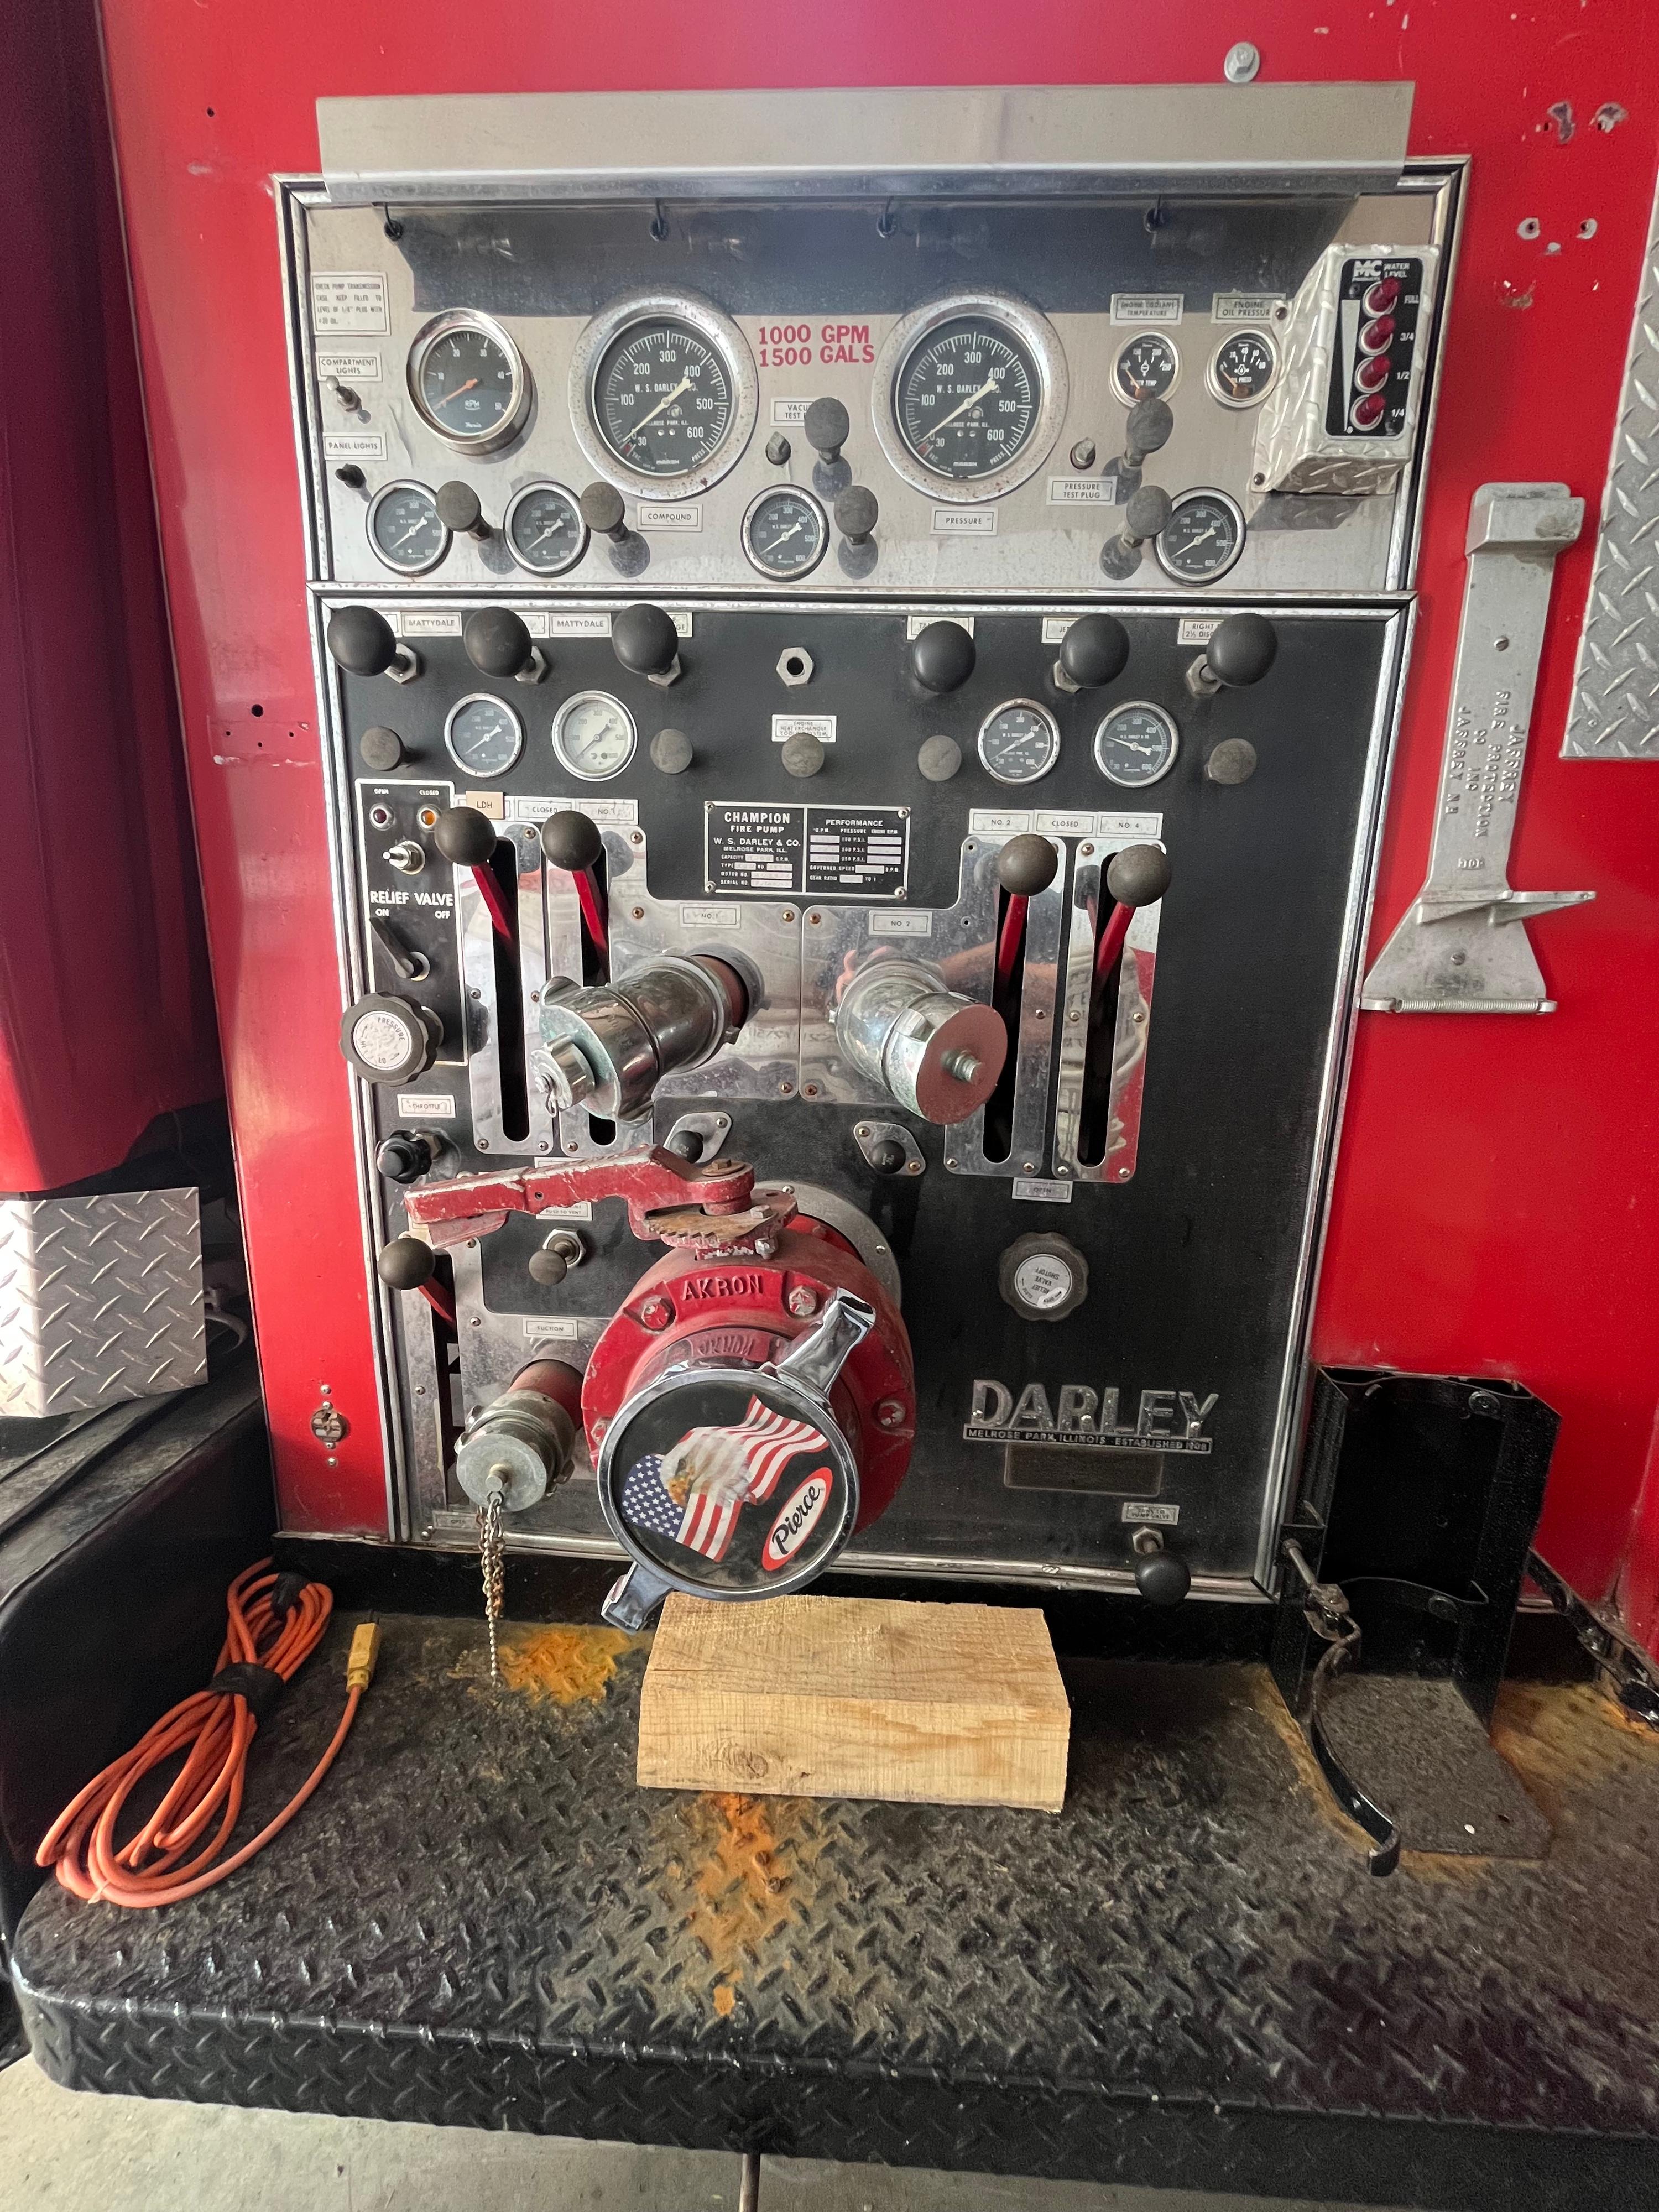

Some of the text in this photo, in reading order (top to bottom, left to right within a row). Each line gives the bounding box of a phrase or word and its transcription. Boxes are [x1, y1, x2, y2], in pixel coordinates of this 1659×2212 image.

[759, 324, 869, 345] 1000 GPM
[1399, 333, 1415, 341] 3/4
[659, 350, 676, 362] 300
[759, 345, 875, 367] 1500 GALS
[964, 352, 982, 363] 300
[633, 363, 650, 375] 200
[684, 366, 700, 377] 400
[937, 364, 953, 375] 200
[988, 367, 1005, 379] 400
[1396, 372, 1410, 380] 1/2
[634, 384, 643, 393] W.
[645, 384, 652, 393] S.
[937, 385, 945, 393] W.
[947, 384, 954, 393] S.
[620, 394, 634, 405] 100
[696, 398, 713, 410] 500
[921, 394, 935, 406] 100
[999, 401, 1016, 412] 500
[1391, 409, 1405, 417] 1/4
[687, 426, 704, 438] 600
[987, 429, 1004, 441] 600
[638, 436, 646, 446] 30
[935, 438, 945, 447] 30
[1449, 706, 1472, 780] JAFFREY
[1474, 690, 1510, 838] FIRE PROTECTION
[1498, 724, 1525, 804] JAFFREY
[476, 801, 492, 809] LDH
[724, 812, 790, 823] CHAMPION
[370, 891, 454, 906] RELIEF VALVE
[375, 909, 389, 917] ON
[378, 1017, 405, 1041] PRESSURE
[1035, 1267, 1060, 1280] SHUTOFF
[1035, 1275, 1052, 1286] VALVE
[681, 1274, 764, 1300] AKRON
[1031, 1284, 1050, 1295] RELIEF
[970, 1379, 1219, 1439] DARLEY
[968, 1428, 1021, 1439] MELROSE
[1059, 1434, 1106, 1444] ILLINOIS
[1115, 1437, 1183, 1449] ESTABLISHED
[772, 1486, 821, 1555] Pierce
